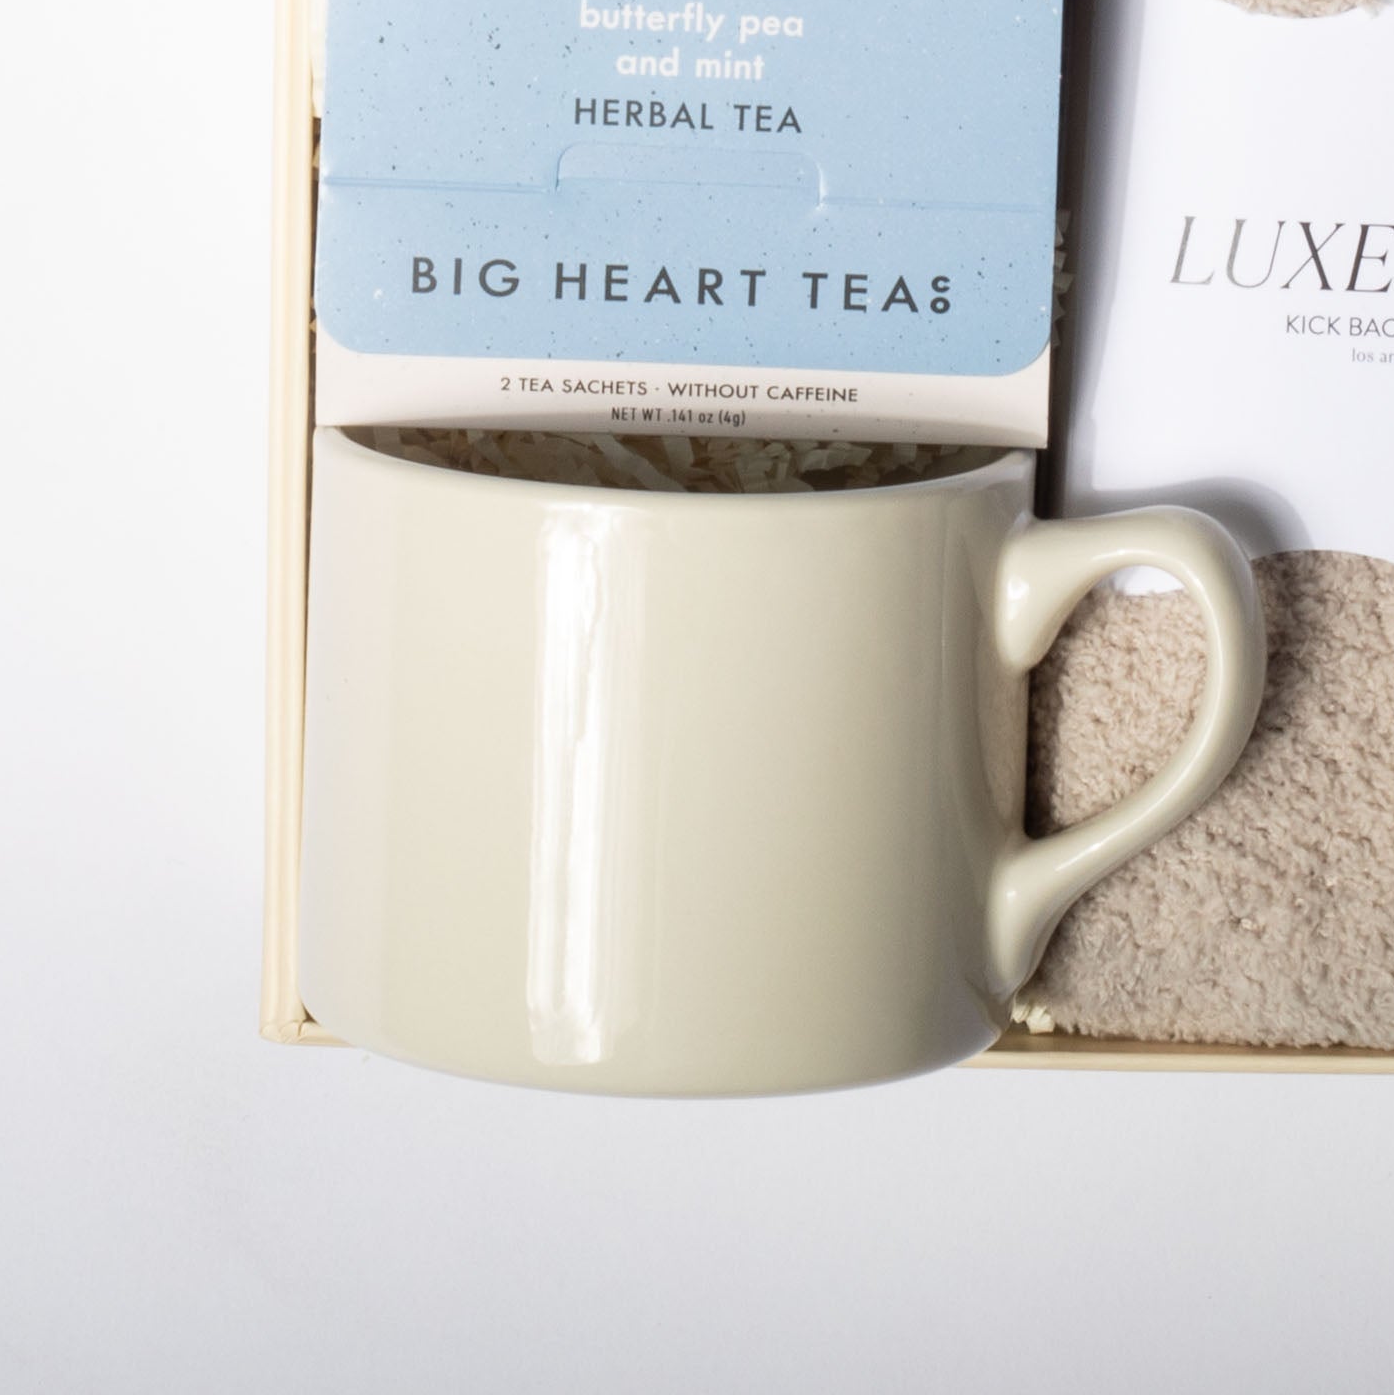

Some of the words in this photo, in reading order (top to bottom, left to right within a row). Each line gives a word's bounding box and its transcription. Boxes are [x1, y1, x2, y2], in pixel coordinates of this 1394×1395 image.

[739, 12, 804, 43] pea
[616, 48, 682, 79] and
[695, 49, 765, 81] mint
[573, 97, 715, 132] HERBAL
[733, 103, 803, 135] TEA
[411, 256, 521, 297] BIG
[554, 261, 767, 307] HEART
[804, 271, 919, 314] TEA
[1286, 315, 1341, 337] KICK
[1351, 348, 1374, 363] los
[500, 376, 511, 393] 2
[519, 377, 555, 394] TEA
[562, 379, 648, 398] SACHETS
[667, 382, 759, 401] WITHOUT
[766, 384, 859, 403] CAFFEINE
[611, 407, 637, 421] NET
[642, 408, 662, 422] WT
[667, 409, 692, 423] .141
[698, 412, 714, 424] oz
[718, 410, 746, 427] (4g)
